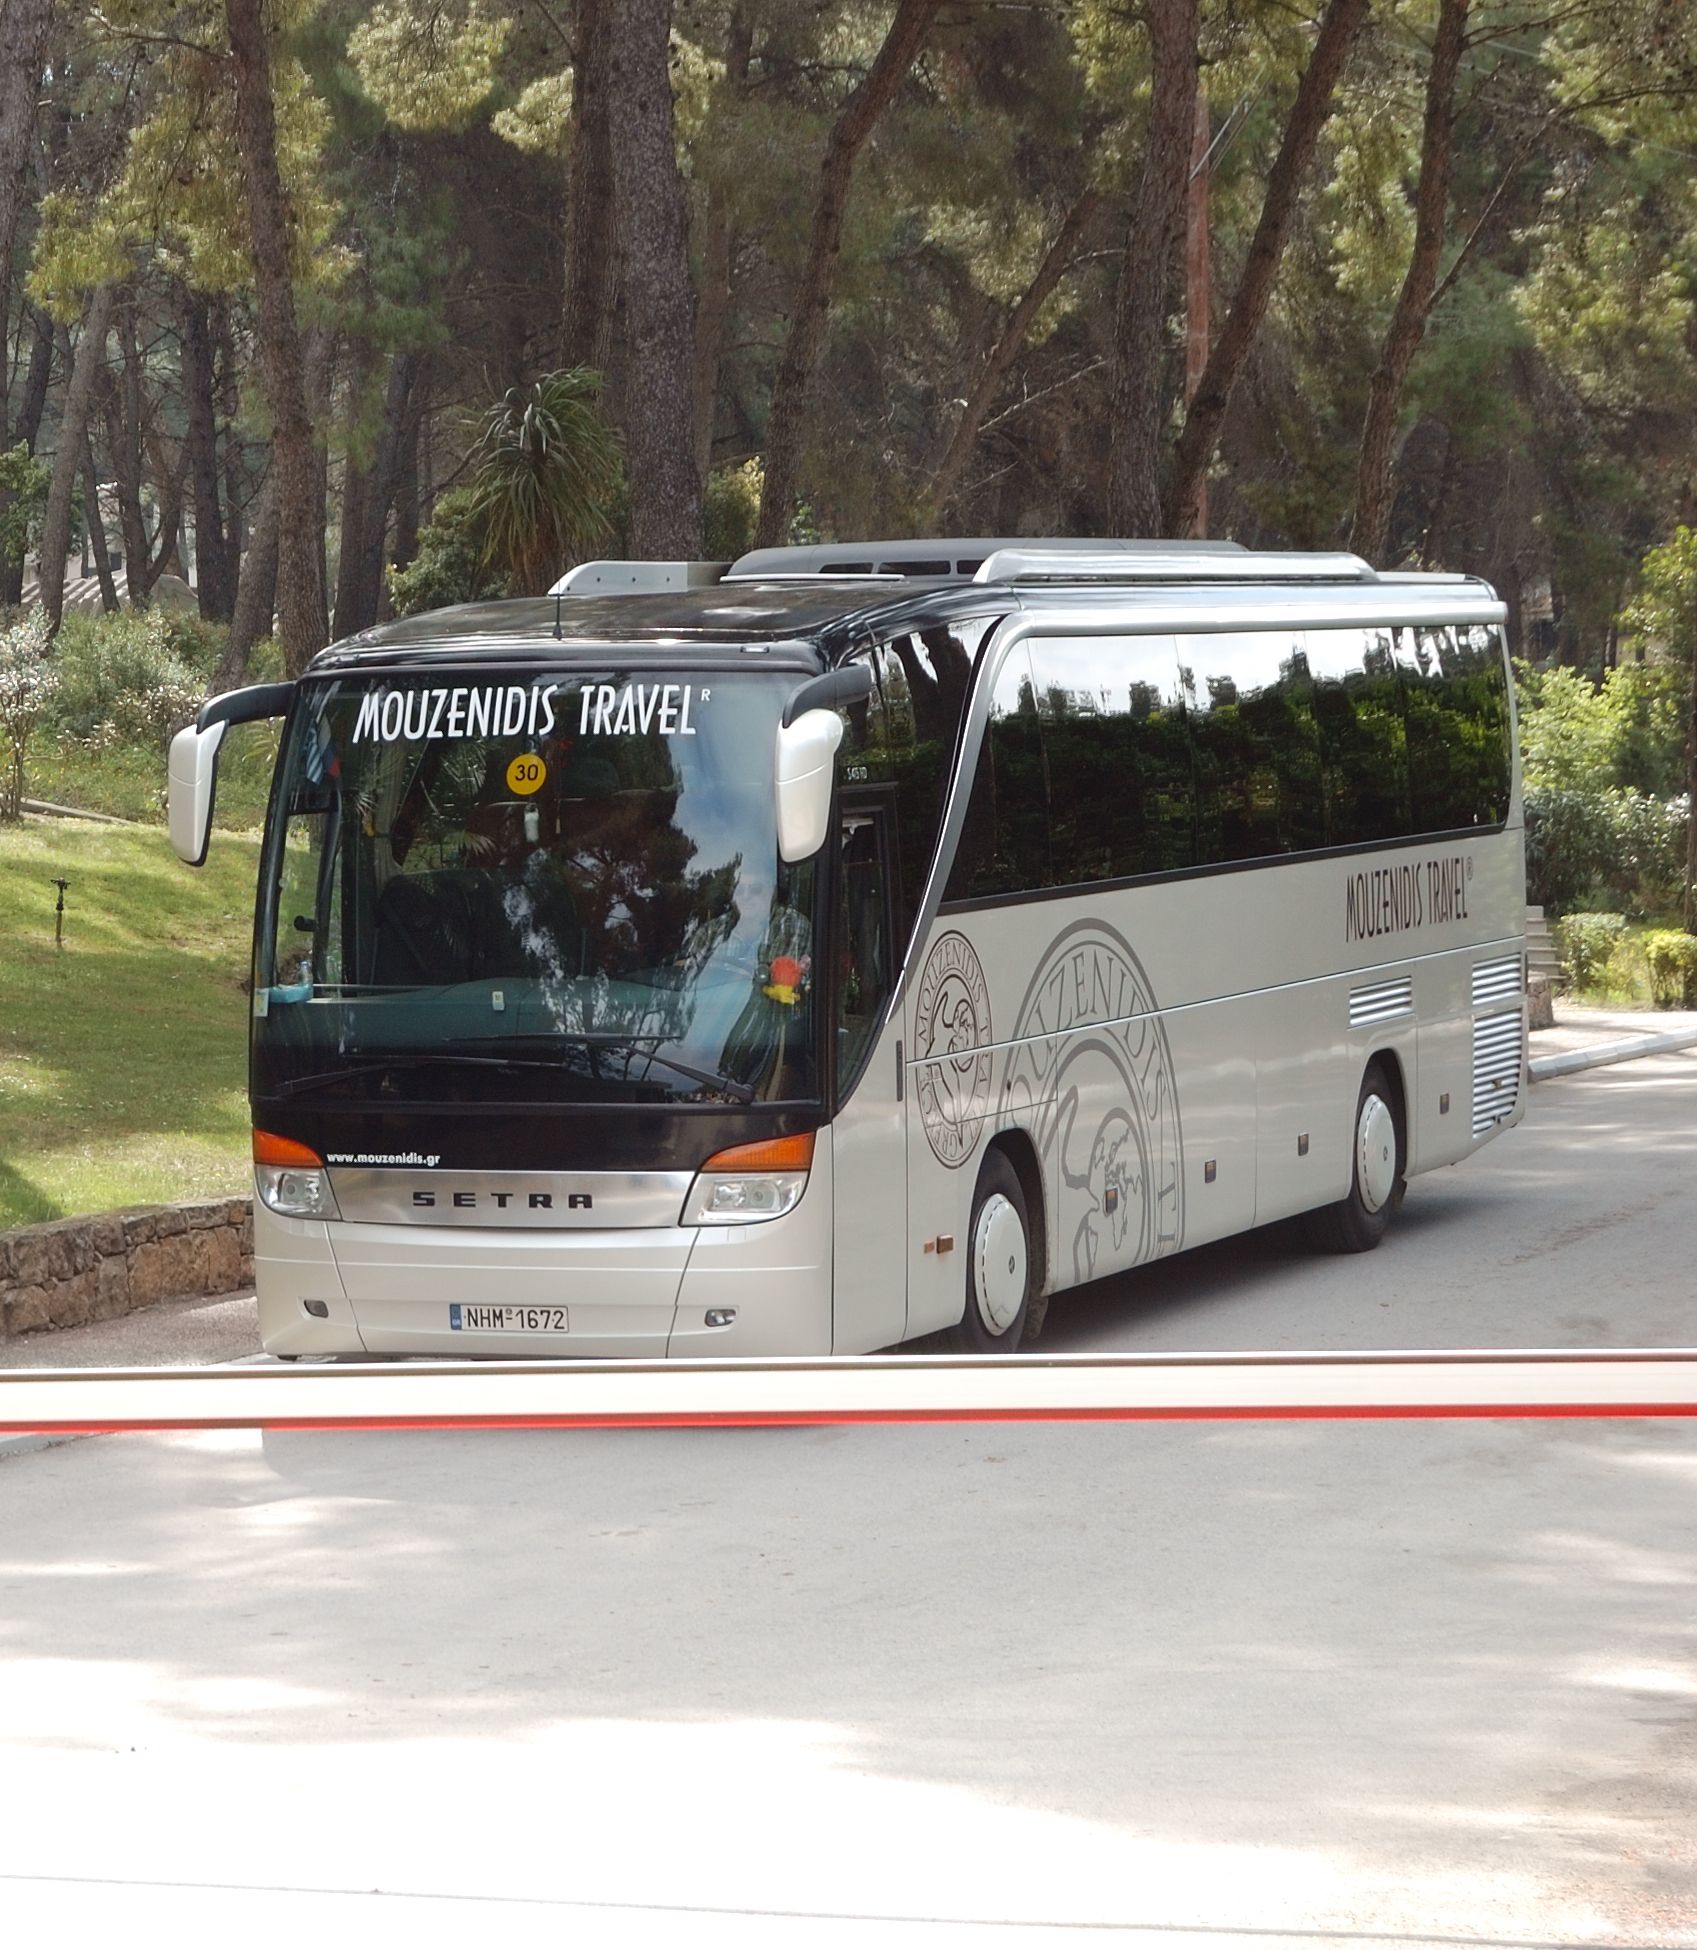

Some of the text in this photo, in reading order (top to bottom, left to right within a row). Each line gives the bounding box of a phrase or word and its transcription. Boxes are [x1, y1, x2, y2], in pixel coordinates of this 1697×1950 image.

[352, 684, 559, 743] MOUZENIDIS
[580, 683, 697, 735] TRAVEL
[514, 764, 539, 782] 30
[1346, 861, 1423, 943] MOUZENIDIS
[326, 1152, 440, 1167] www.mouzenidis.gr
[412, 1191, 592, 1209] SETRA
